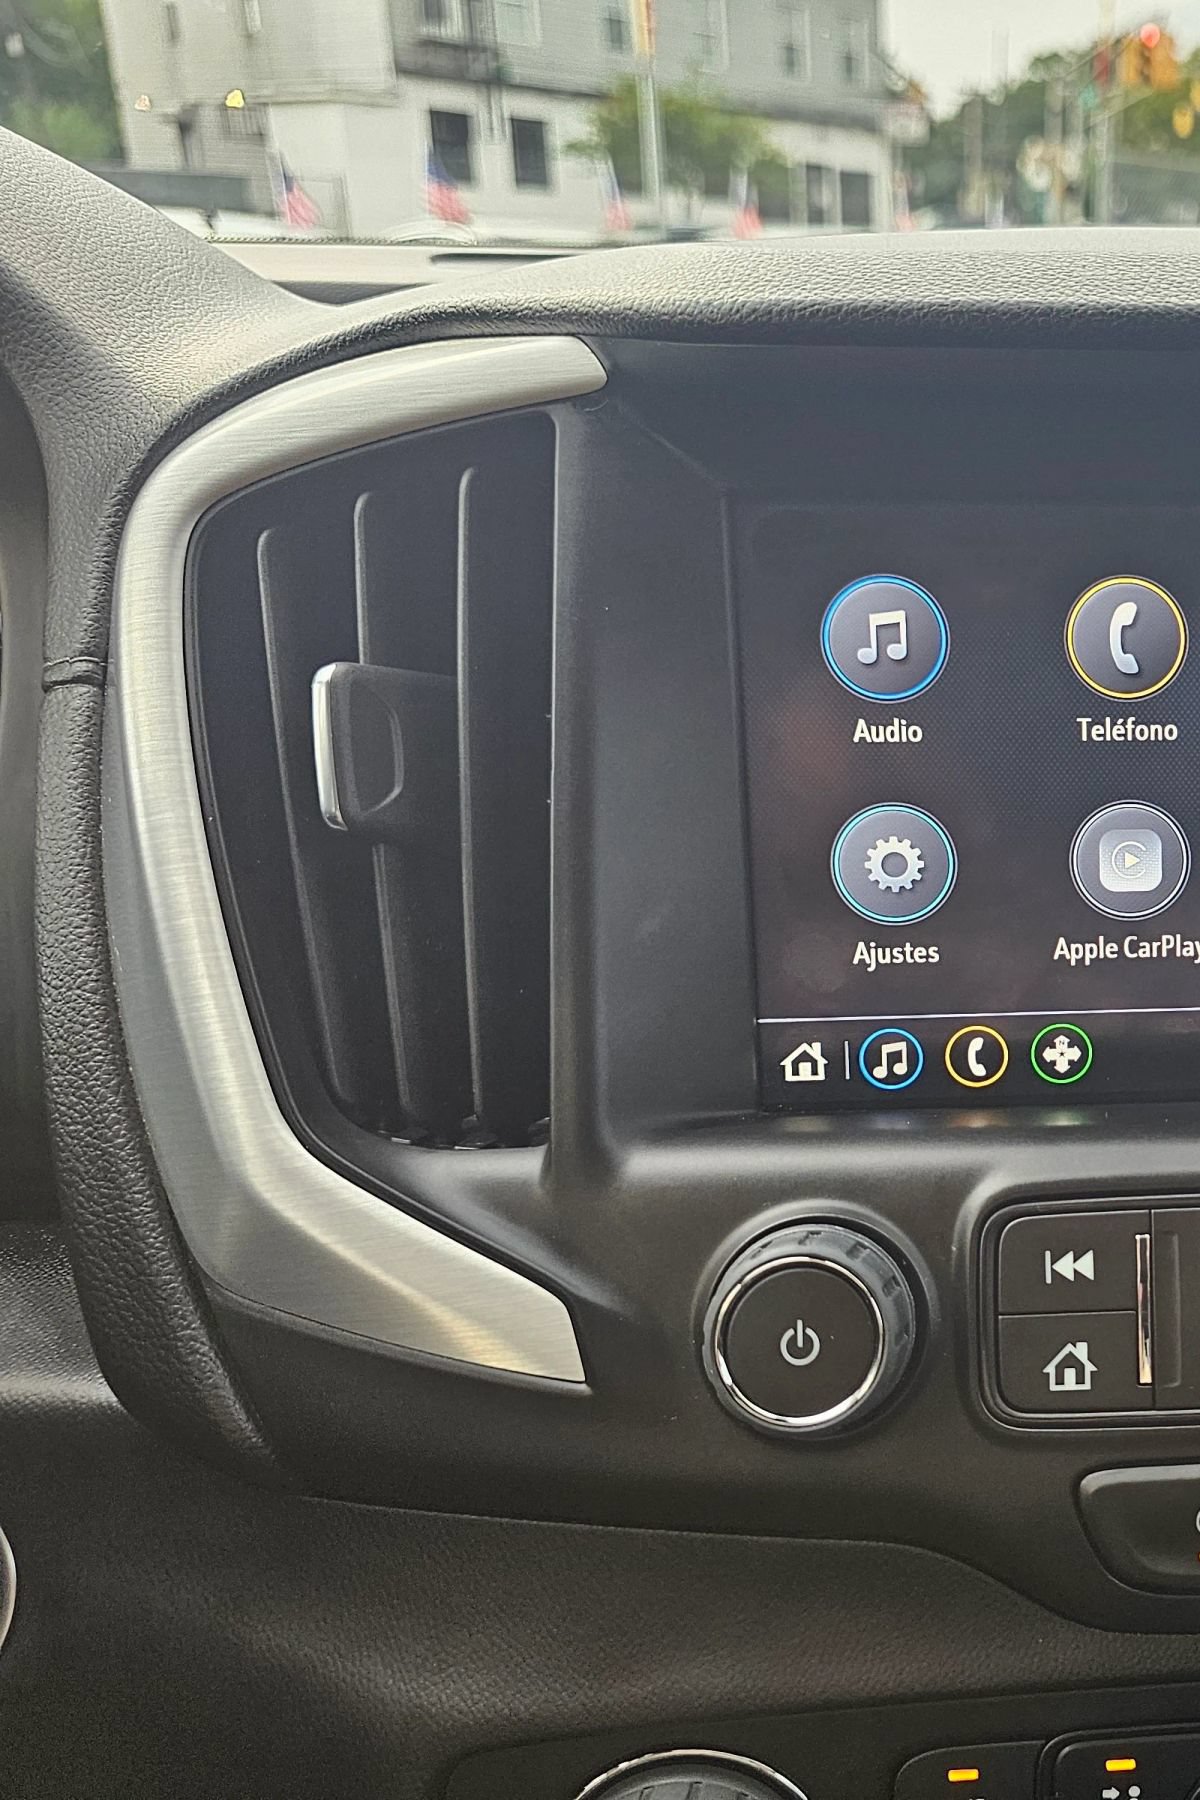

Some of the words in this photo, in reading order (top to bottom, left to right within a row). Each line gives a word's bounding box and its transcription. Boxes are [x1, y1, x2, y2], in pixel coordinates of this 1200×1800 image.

[852, 717, 923, 744] Audio
[1076, 716, 1179, 742] Teléfono
[852, 940, 940, 972] Ajustes
[1053, 935, 1119, 967] Apple
